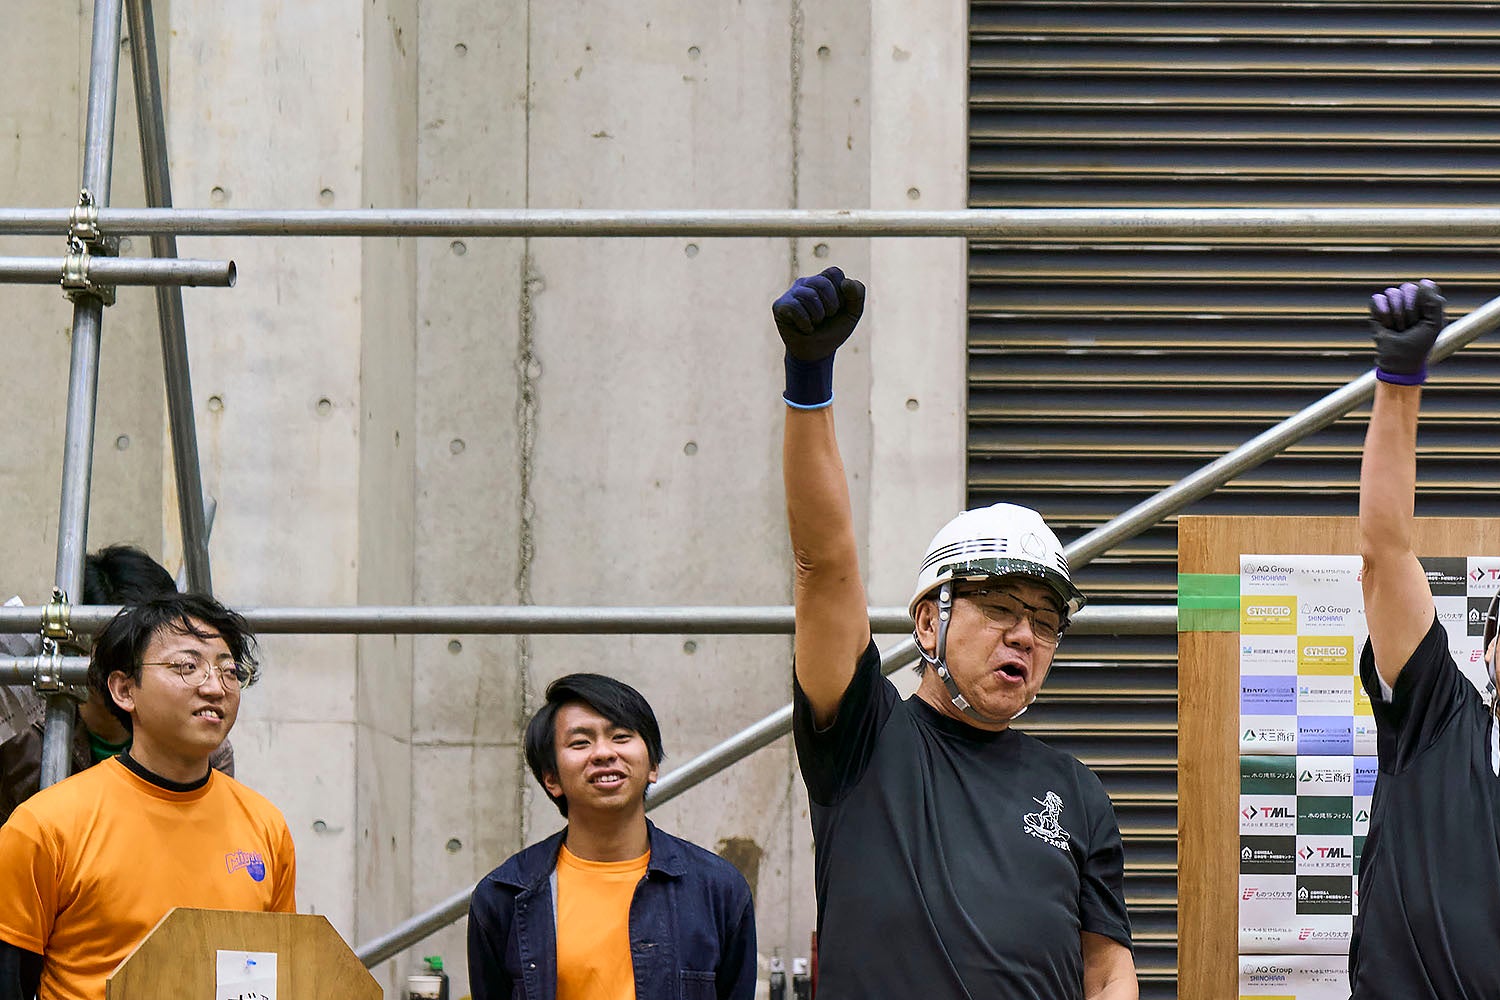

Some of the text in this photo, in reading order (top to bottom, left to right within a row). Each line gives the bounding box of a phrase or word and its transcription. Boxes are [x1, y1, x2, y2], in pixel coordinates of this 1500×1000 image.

[1270, 565, 1294, 574] Group
[1249, 607, 1288, 615] SYNEGIC
[1313, 605, 1350, 614] AQ Group
[1306, 647, 1344, 655] SYNEGIC
[1258, 731, 1294, 742] 大三商行
[1315, 772, 1350, 783] 大三商行
[1260, 807, 1294, 818] TML
[1316, 847, 1351, 858] TML
[1255, 965, 1292, 974] AQ Group
